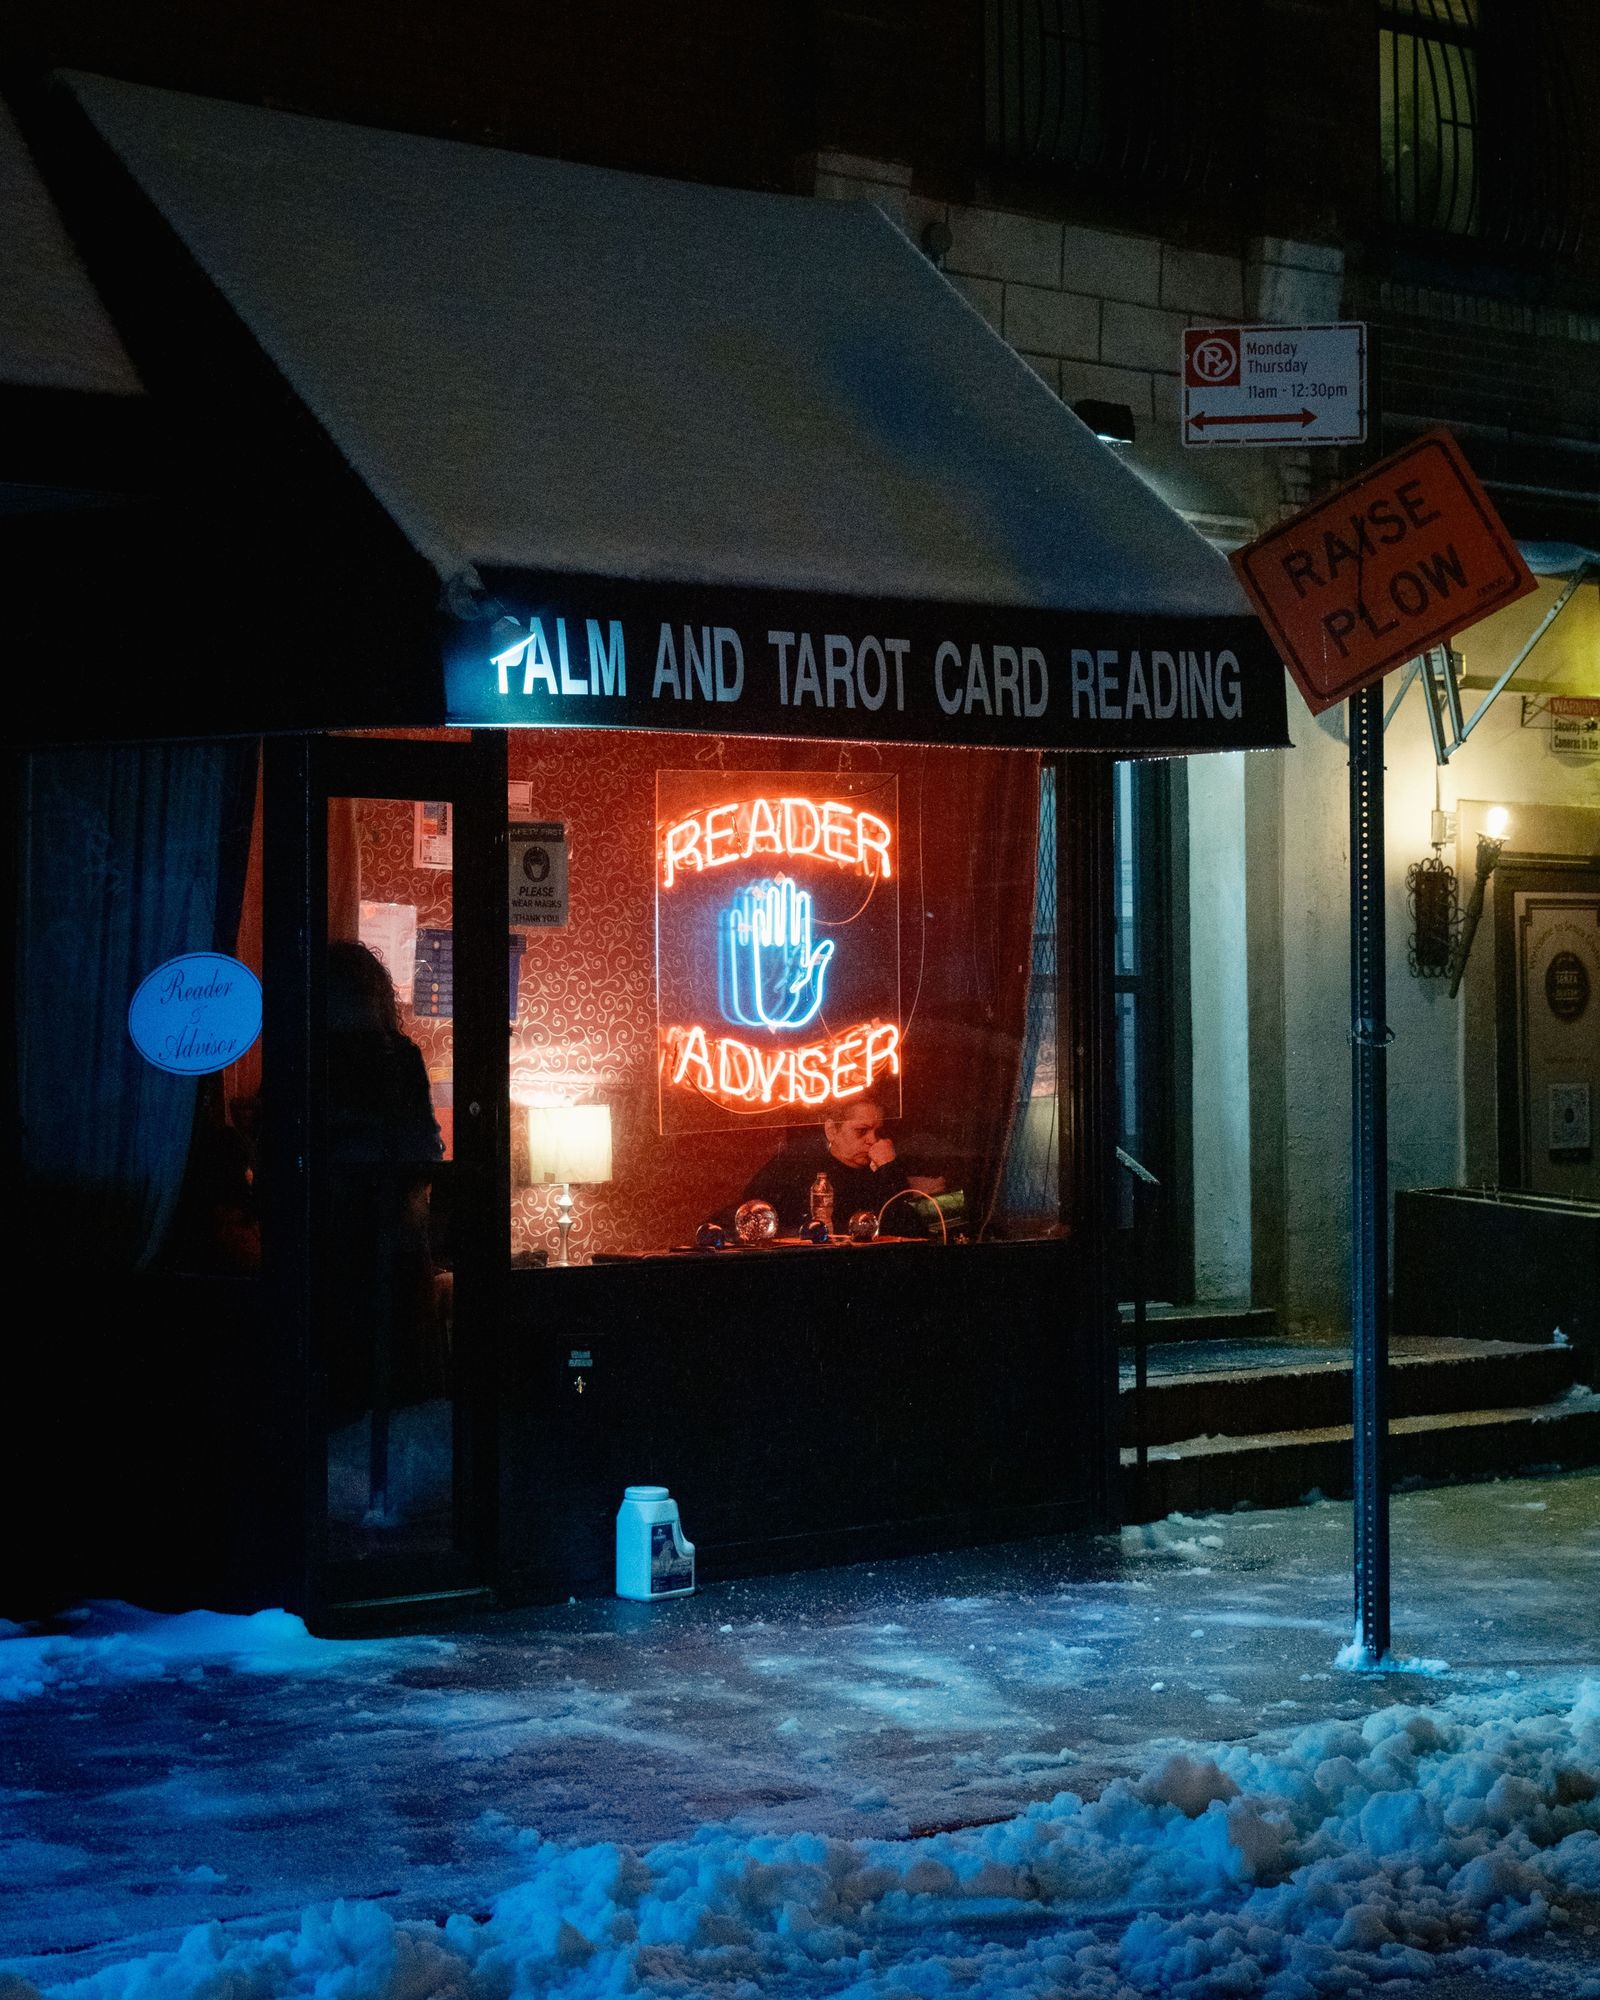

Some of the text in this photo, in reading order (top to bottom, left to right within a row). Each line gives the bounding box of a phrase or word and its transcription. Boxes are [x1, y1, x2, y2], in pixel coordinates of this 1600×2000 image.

[1246, 340, 1298, 357] Monday
[1247, 358, 1308, 375] Thursday
[1247, 384, 1278, 399] 11am
[1291, 383, 1348, 399] 12:30pm
[1281, 479, 1442, 598] RAISE
[1324, 543, 1468, 657] PLOW
[651, 622, 745, 703] AND
[767, 629, 910, 712] TAROT
[934, 640, 1049, 718] CARD
[1070, 648, 1242, 720] READING
[663, 797, 892, 888] READER
[511, 899, 562, 908] WEAR MASKS
[518, 886, 555, 897] PLEASE
[512, 913, 541, 923] THANK
[160, 967, 233, 1005] Reader
[672, 1023, 900, 1105] ADVISER
